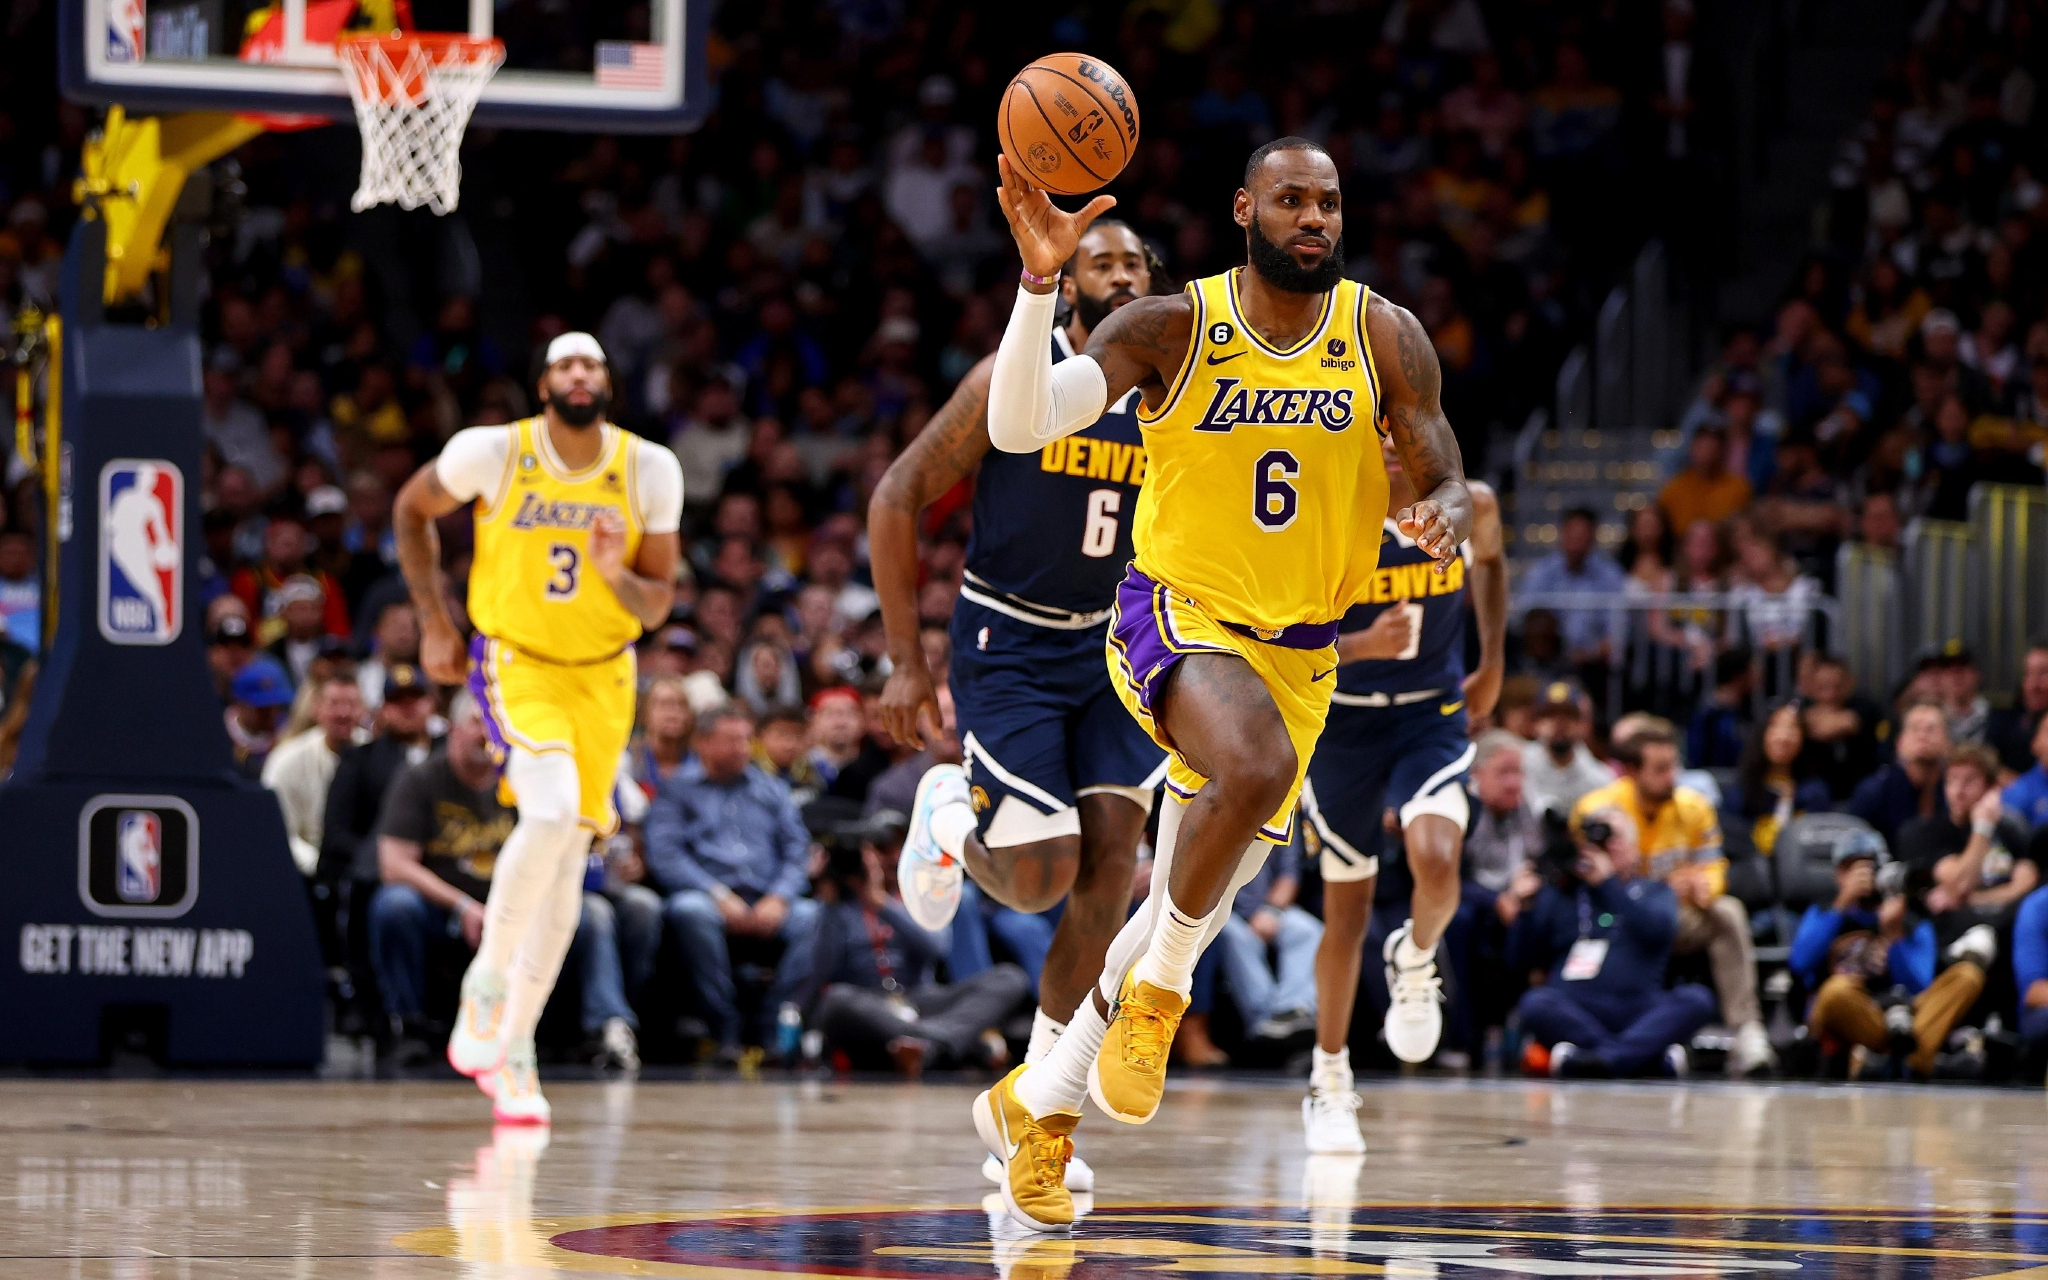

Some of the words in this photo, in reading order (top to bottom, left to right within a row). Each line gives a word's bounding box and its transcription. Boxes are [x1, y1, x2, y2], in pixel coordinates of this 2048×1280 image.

[1214, 325, 1228, 343] 6
[1320, 358, 1355, 371] bibigo
[1192, 377, 1354, 433] LAKERS
[1040, 435, 1148, 487] DENVE
[1251, 448, 1301, 533] 6
[1081, 488, 1122, 558] 6
[546, 543, 582, 601] 3
[20, 923, 77, 975] GET
[78, 925, 131, 976] THE
[132, 926, 197, 977] NEW
[196, 928, 254, 978] APP
